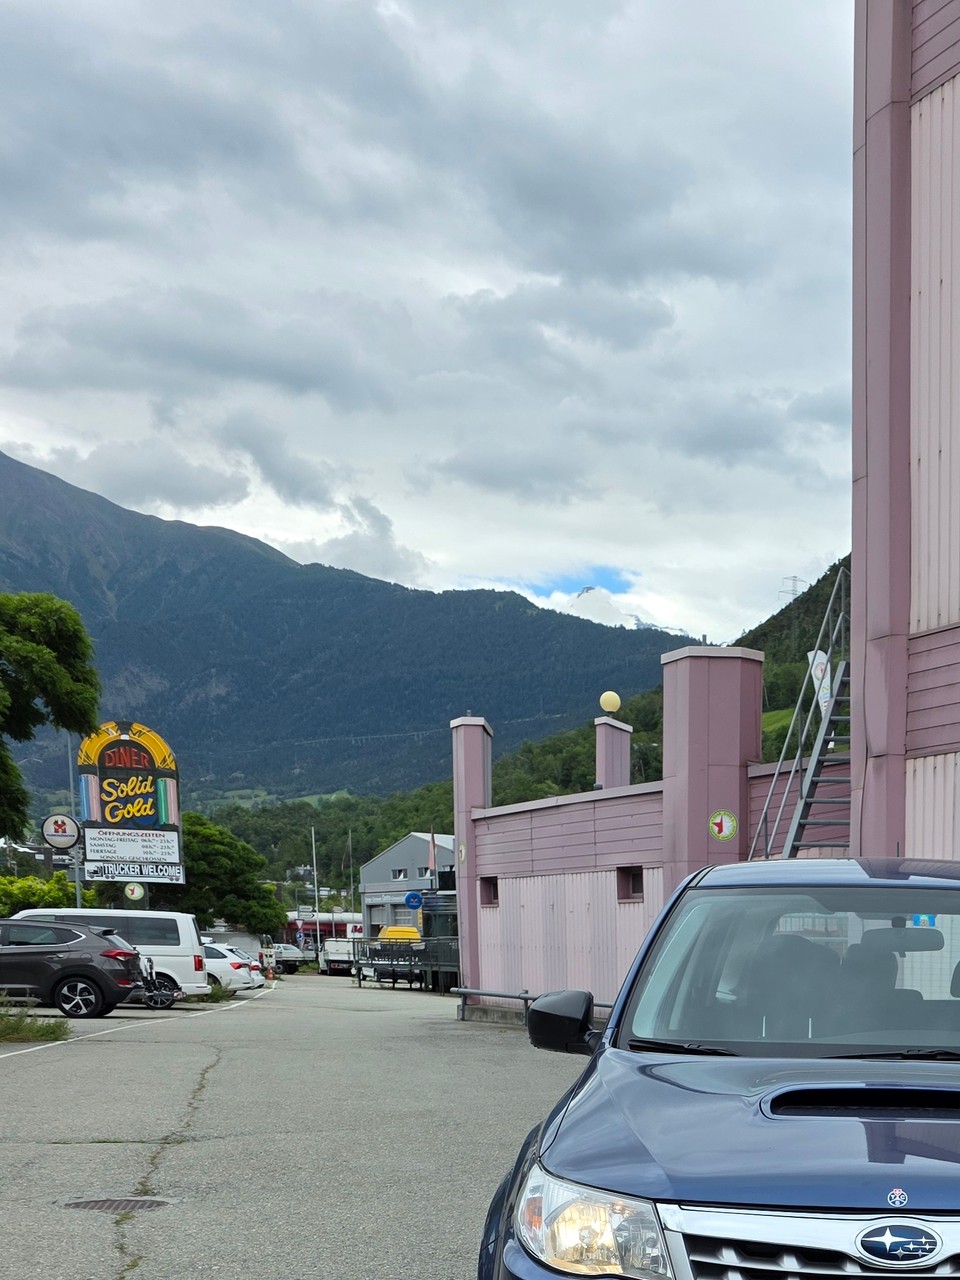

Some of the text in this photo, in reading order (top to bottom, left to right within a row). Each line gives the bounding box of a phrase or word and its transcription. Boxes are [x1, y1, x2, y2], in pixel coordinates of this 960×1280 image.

[105, 747, 151, 768] DINER
[101, 776, 154, 801] Solid
[105, 798, 155, 823] Gold
[98, 830, 165, 838] ÖFFNUNGSZEITEN
[103, 864, 181, 876] TRUCKER WELCOME
